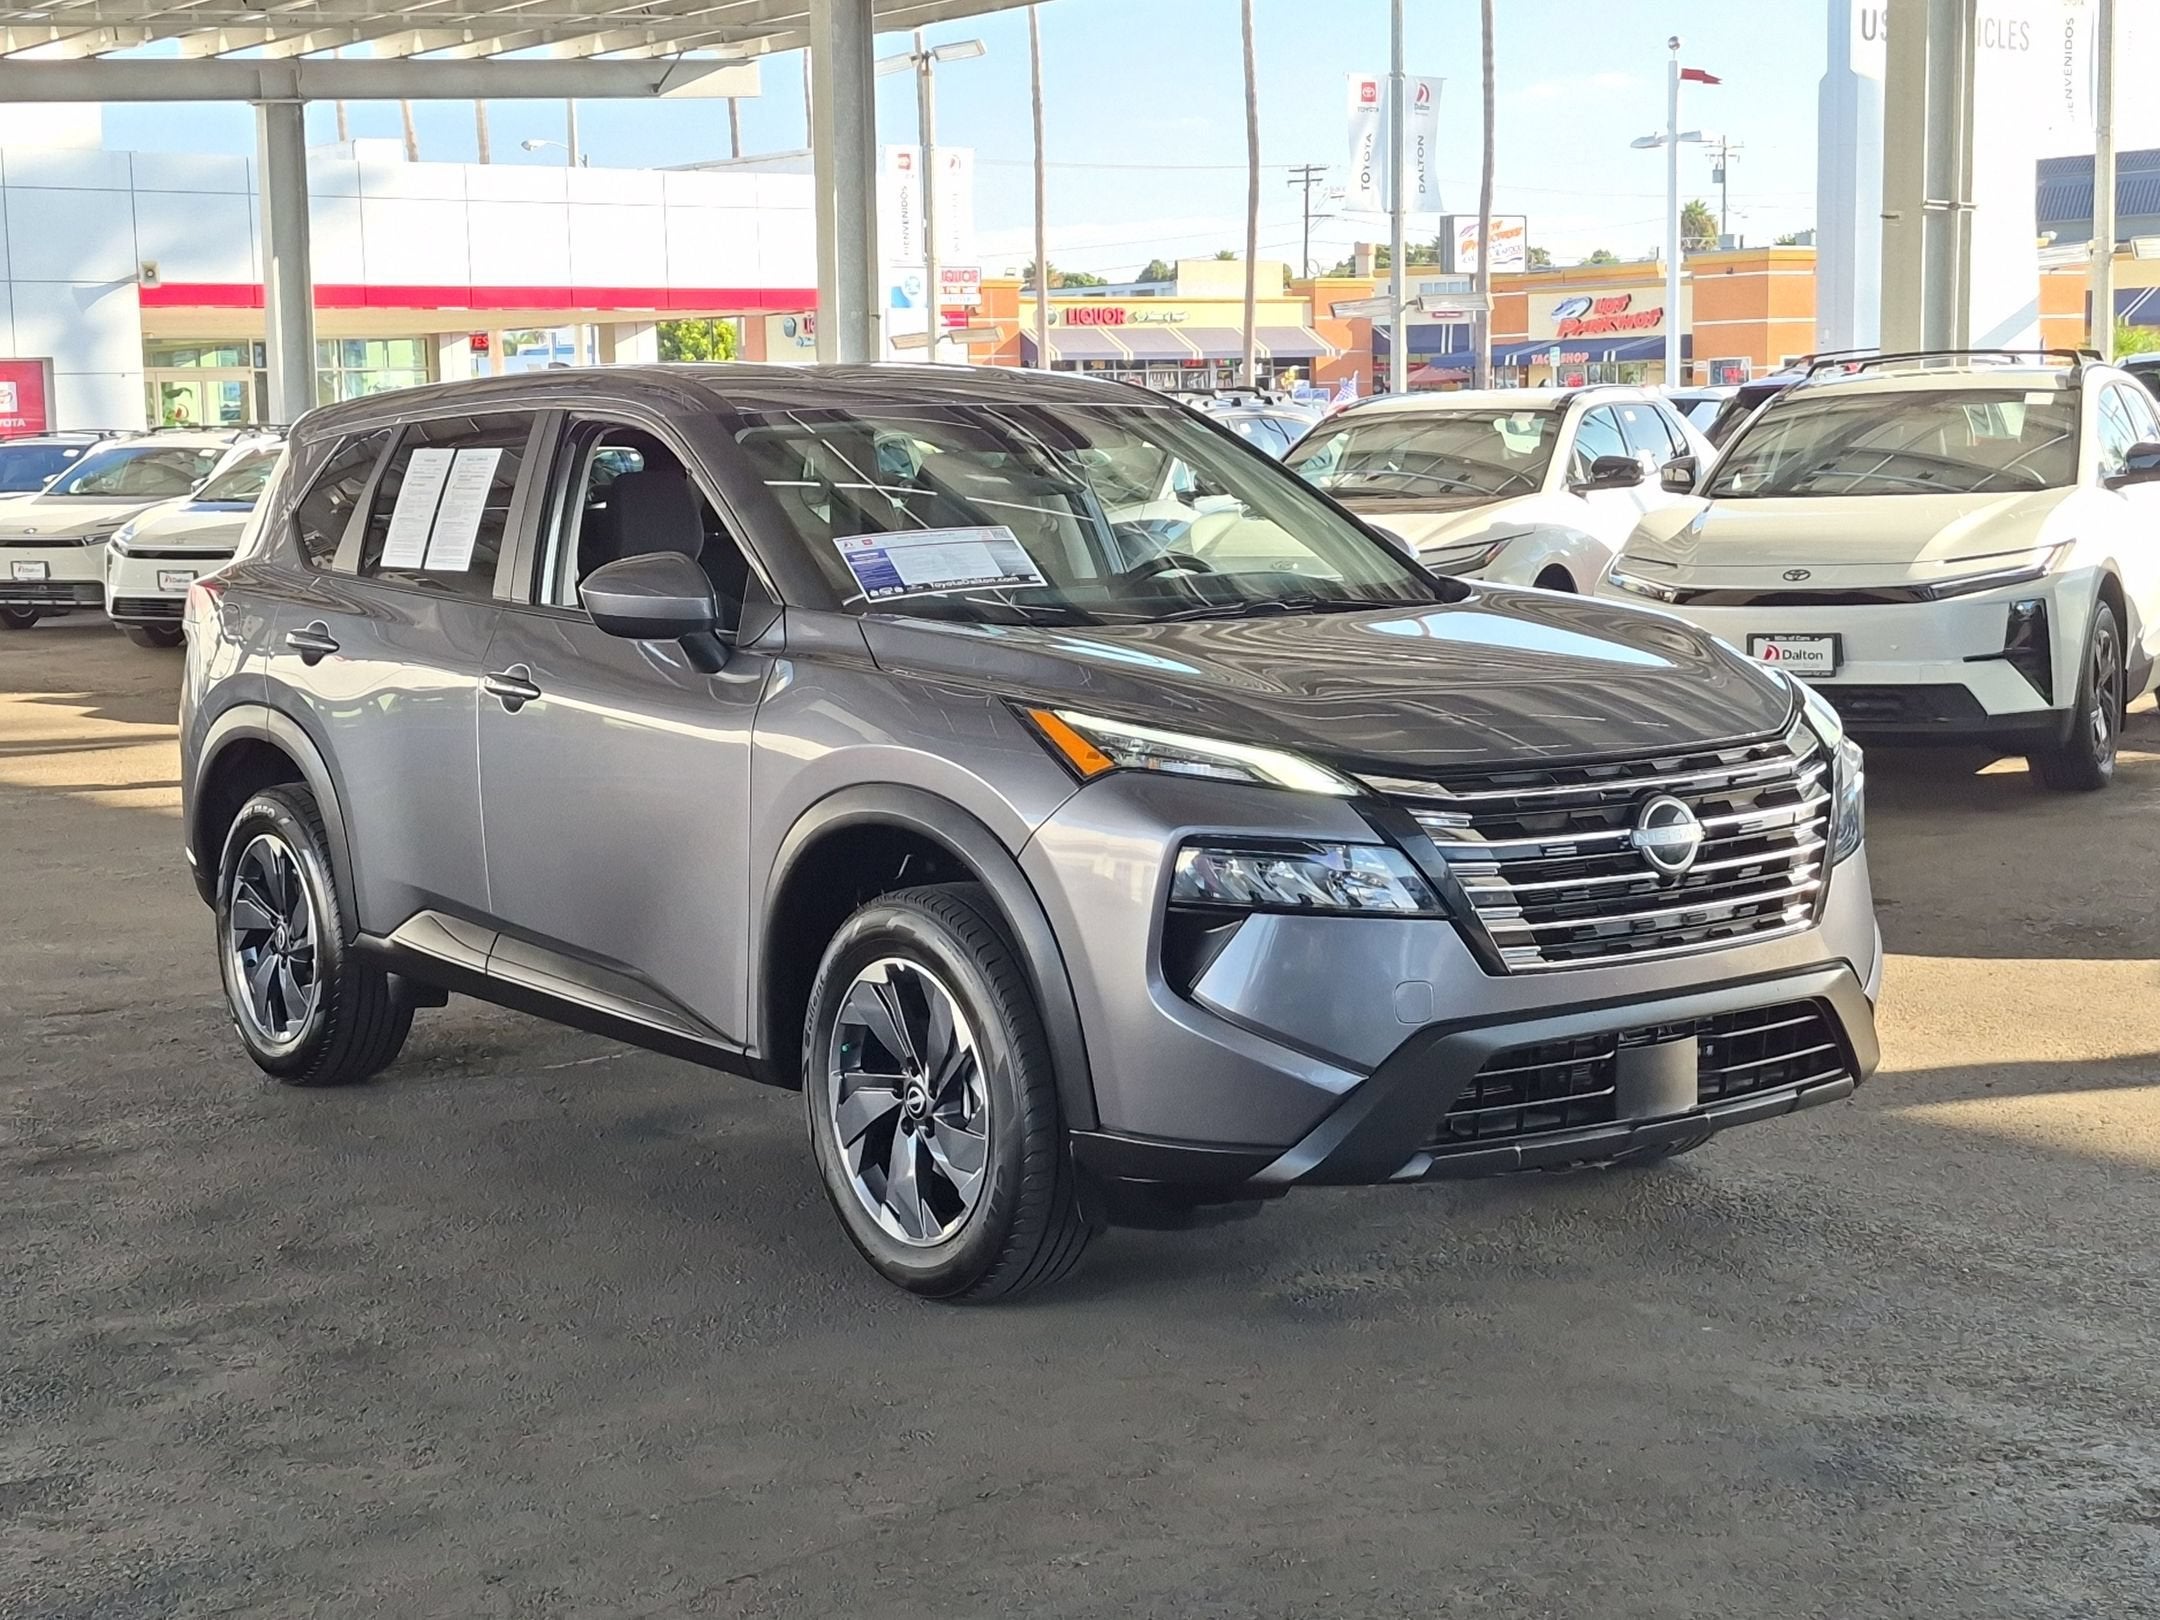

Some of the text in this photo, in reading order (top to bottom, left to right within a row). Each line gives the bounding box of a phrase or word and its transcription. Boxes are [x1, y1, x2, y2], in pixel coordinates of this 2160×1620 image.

[1976, 17, 2031, 51] ICLES
[2063, 16, 2075, 121] IENVENIDOS
[1360, 132, 1372, 192] TOYOTA
[1416, 134, 1426, 194] DALTON
[1064, 307, 1127, 326] LIQUOR
[1530, 353, 1551, 365] TAC
[1560, 351, 1590, 364] SHOP
[1781, 649, 1824, 661] Dalton
